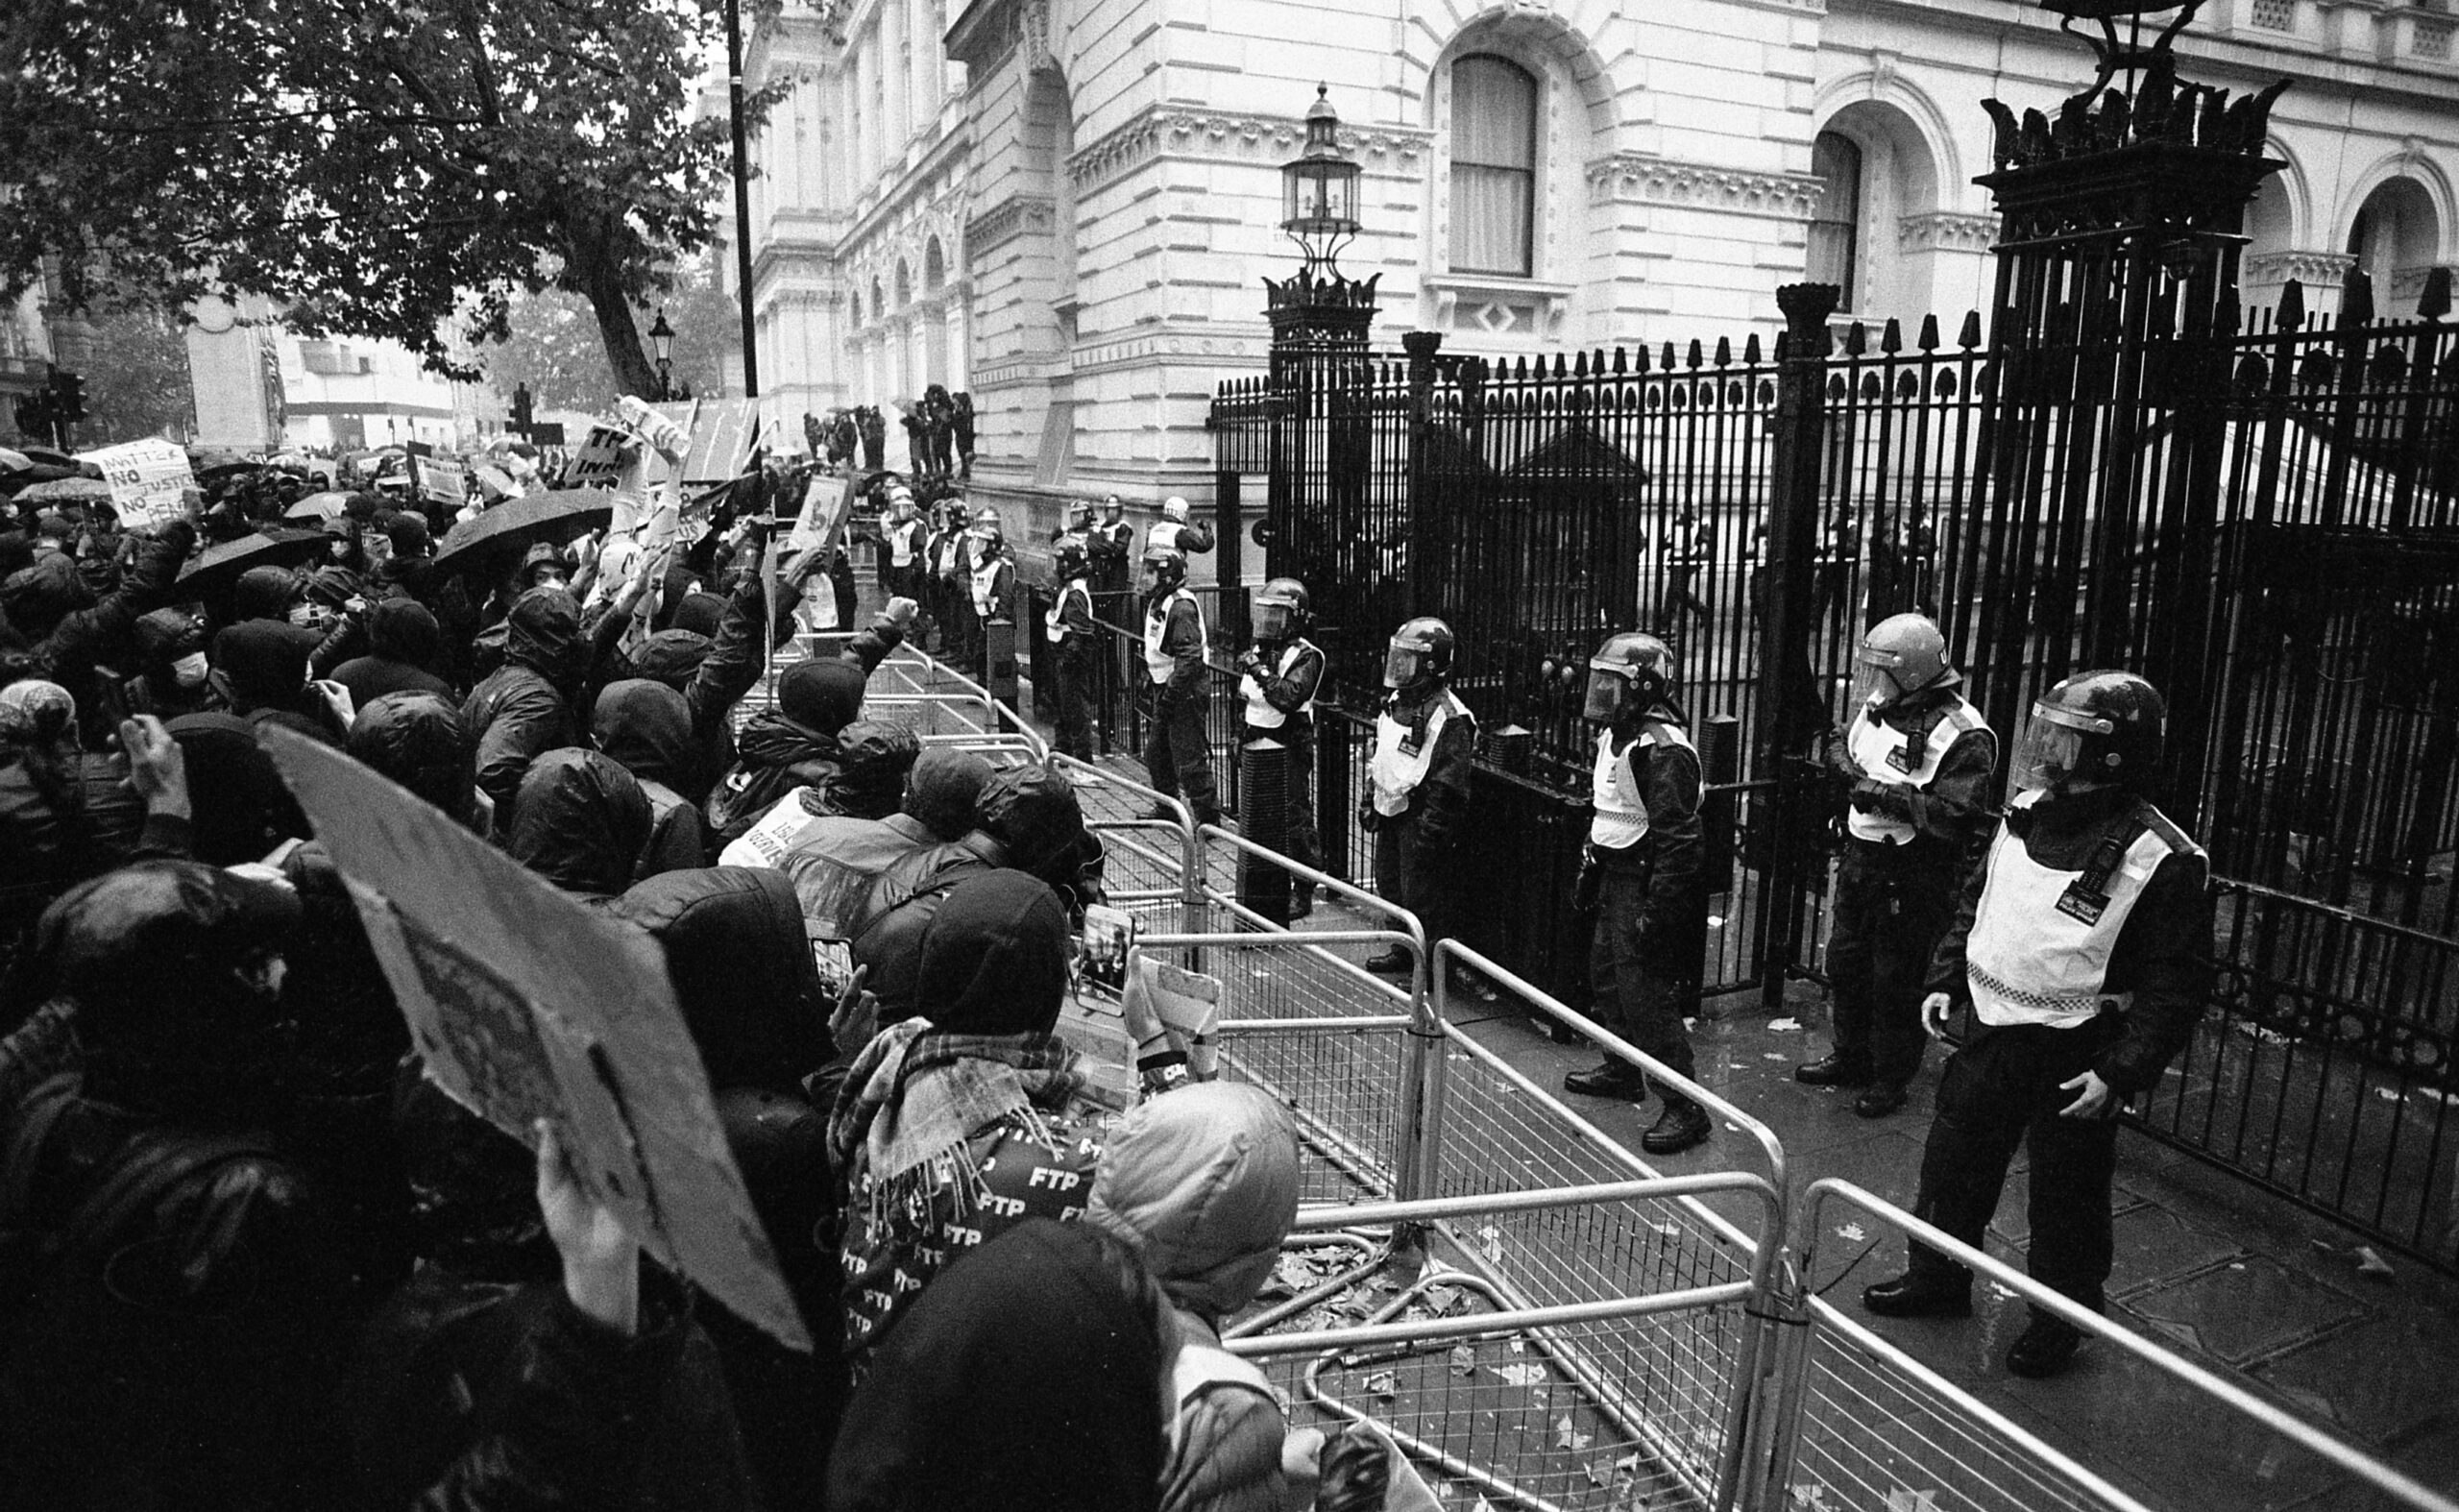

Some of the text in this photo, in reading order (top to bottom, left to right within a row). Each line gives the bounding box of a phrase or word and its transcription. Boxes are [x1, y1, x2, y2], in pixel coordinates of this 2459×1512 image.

[110, 469, 140, 487] NO
[121, 497, 147, 514] NO
[1029, 1166, 1080, 1190] FTP
[978, 1192, 1026, 1217] FTP
[943, 1222, 982, 1246] FTP
[841, 1248, 867, 1275] FTP
[864, 1288, 892, 1312] FTP
[846, 1307, 872, 1332] FTP
